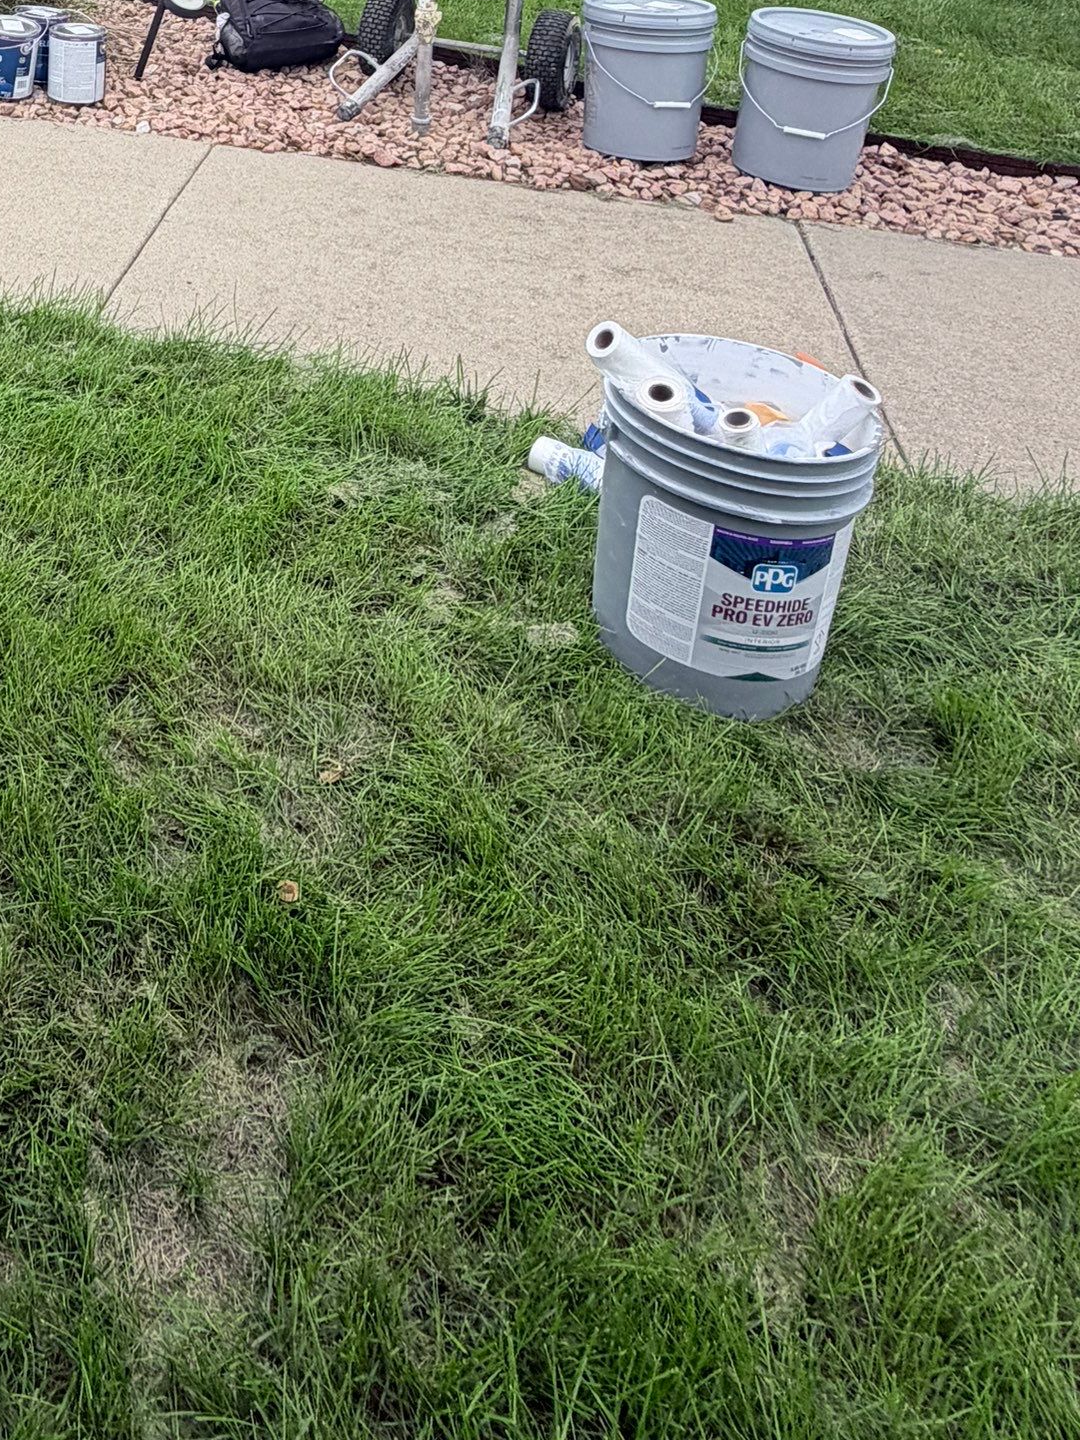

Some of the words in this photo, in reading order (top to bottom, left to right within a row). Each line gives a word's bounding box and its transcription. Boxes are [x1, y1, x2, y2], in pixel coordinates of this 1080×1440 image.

[754, 568, 795, 591] PPG
[721, 592, 811, 614] SPEEDHIDE
[711, 604, 748, 625] PRO
[752, 613, 774, 627] EV
[776, 609, 814, 628] ZERO
